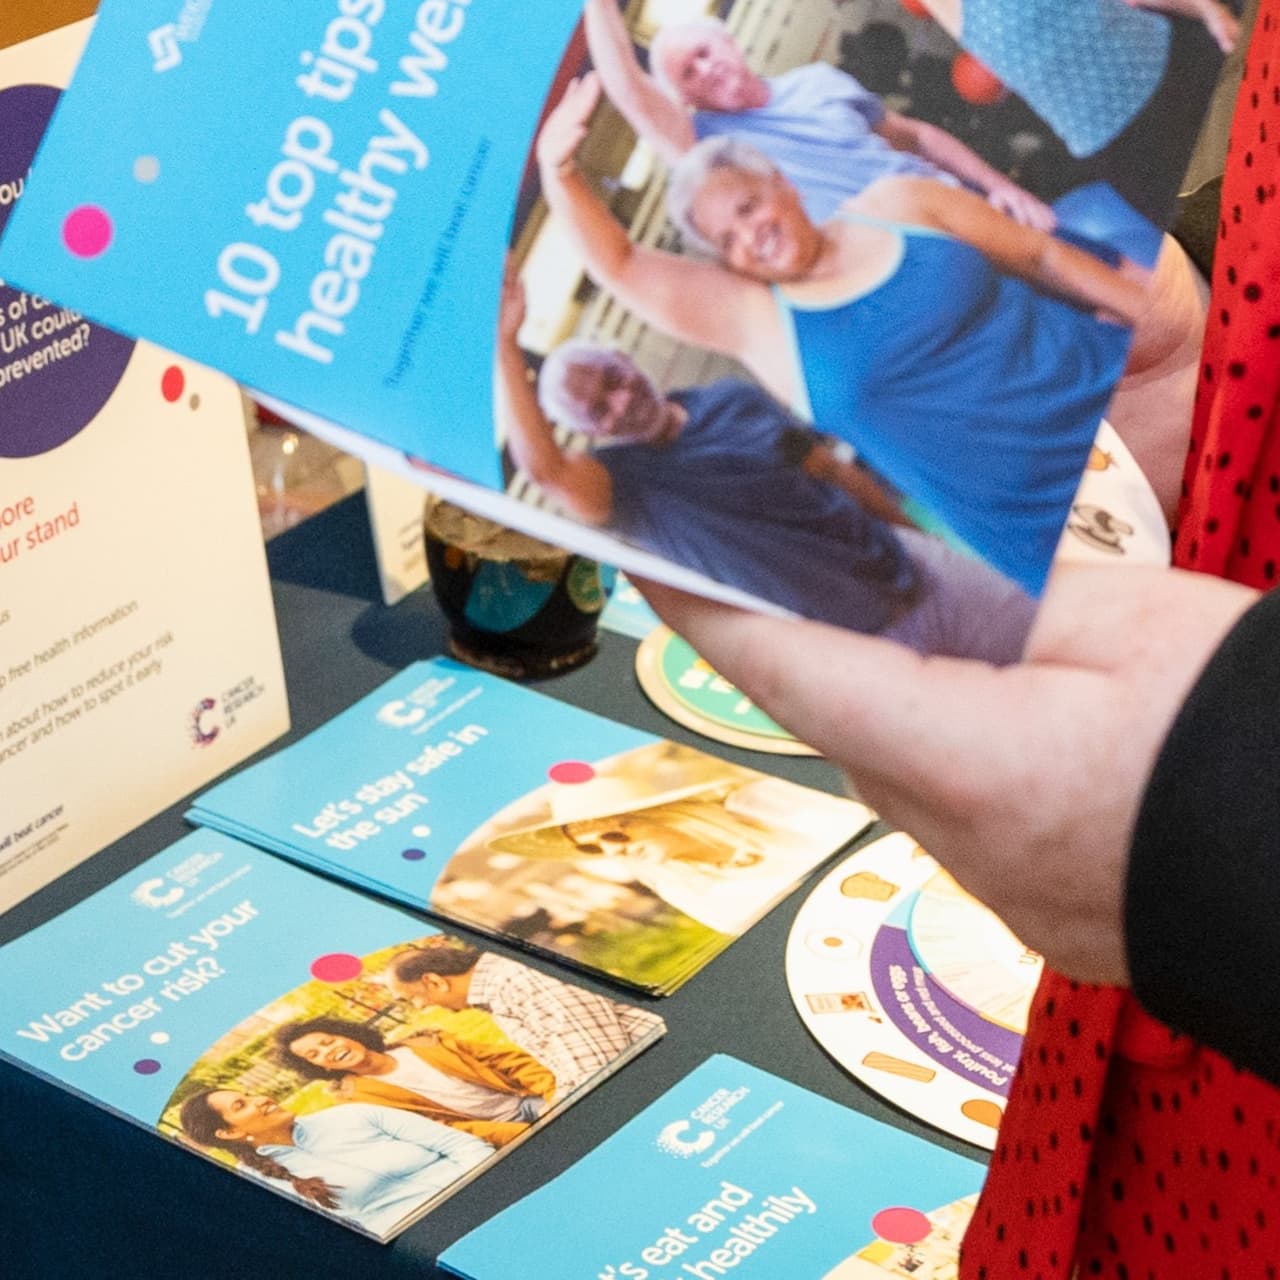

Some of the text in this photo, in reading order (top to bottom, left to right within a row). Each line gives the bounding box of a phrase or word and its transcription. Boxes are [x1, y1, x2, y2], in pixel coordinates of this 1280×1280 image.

[204, 242, 281, 334] 10
[244, 115, 339, 232] top
[274, 107, 430, 364] healthy
[0, 322, 29, 353] UK
[8, 292, 28, 320] of
[26, 501, 80, 550] stand
[5, 708, 41, 738] about
[41, 693, 69, 716] how
[70, 684, 84, 700] to
[85, 660, 125, 690] reduce
[127, 644, 153, 668] your
[155, 631, 174, 649] risk
[8, 660, 32, 683] free
[33, 638, 71, 666] health
[73, 599, 139, 645] information
[31, 719, 54, 744] and
[55, 707, 81, 728] how
[83, 697, 97, 713] to
[98, 679, 125, 704] spot
[125, 673, 135, 687] it
[135, 658, 163, 683] early
[292, 724, 489, 838] Let's stay safe in
[325, 792, 429, 850] the sun
[16, 899, 259, 1042] Want to cut your
[60, 956, 226, 1061] cancer risk?
[641, 1228, 699, 1266] eat
[687, 1180, 754, 1233] and
[681, 1186, 817, 1280] healthily
